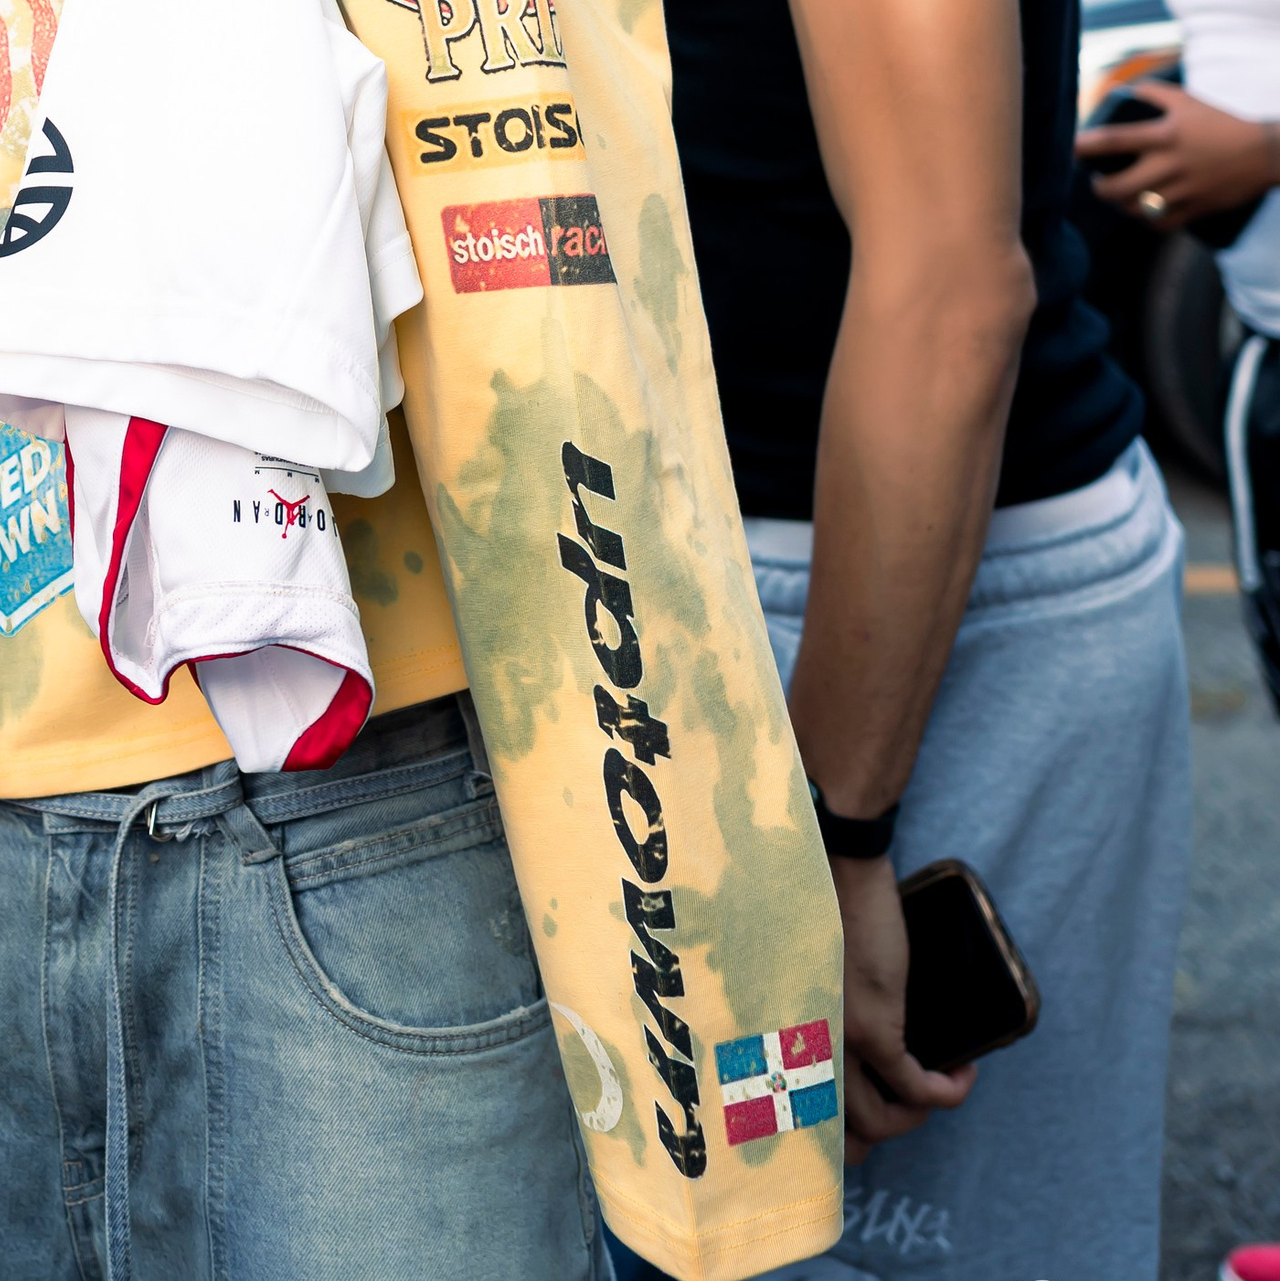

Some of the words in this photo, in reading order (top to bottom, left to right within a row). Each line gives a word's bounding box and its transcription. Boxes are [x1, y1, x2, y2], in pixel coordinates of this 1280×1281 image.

[415, 103, 585, 164] STOIS
[453, 225, 545, 264] stoisch
[556, 439, 707, 1180] uptown
